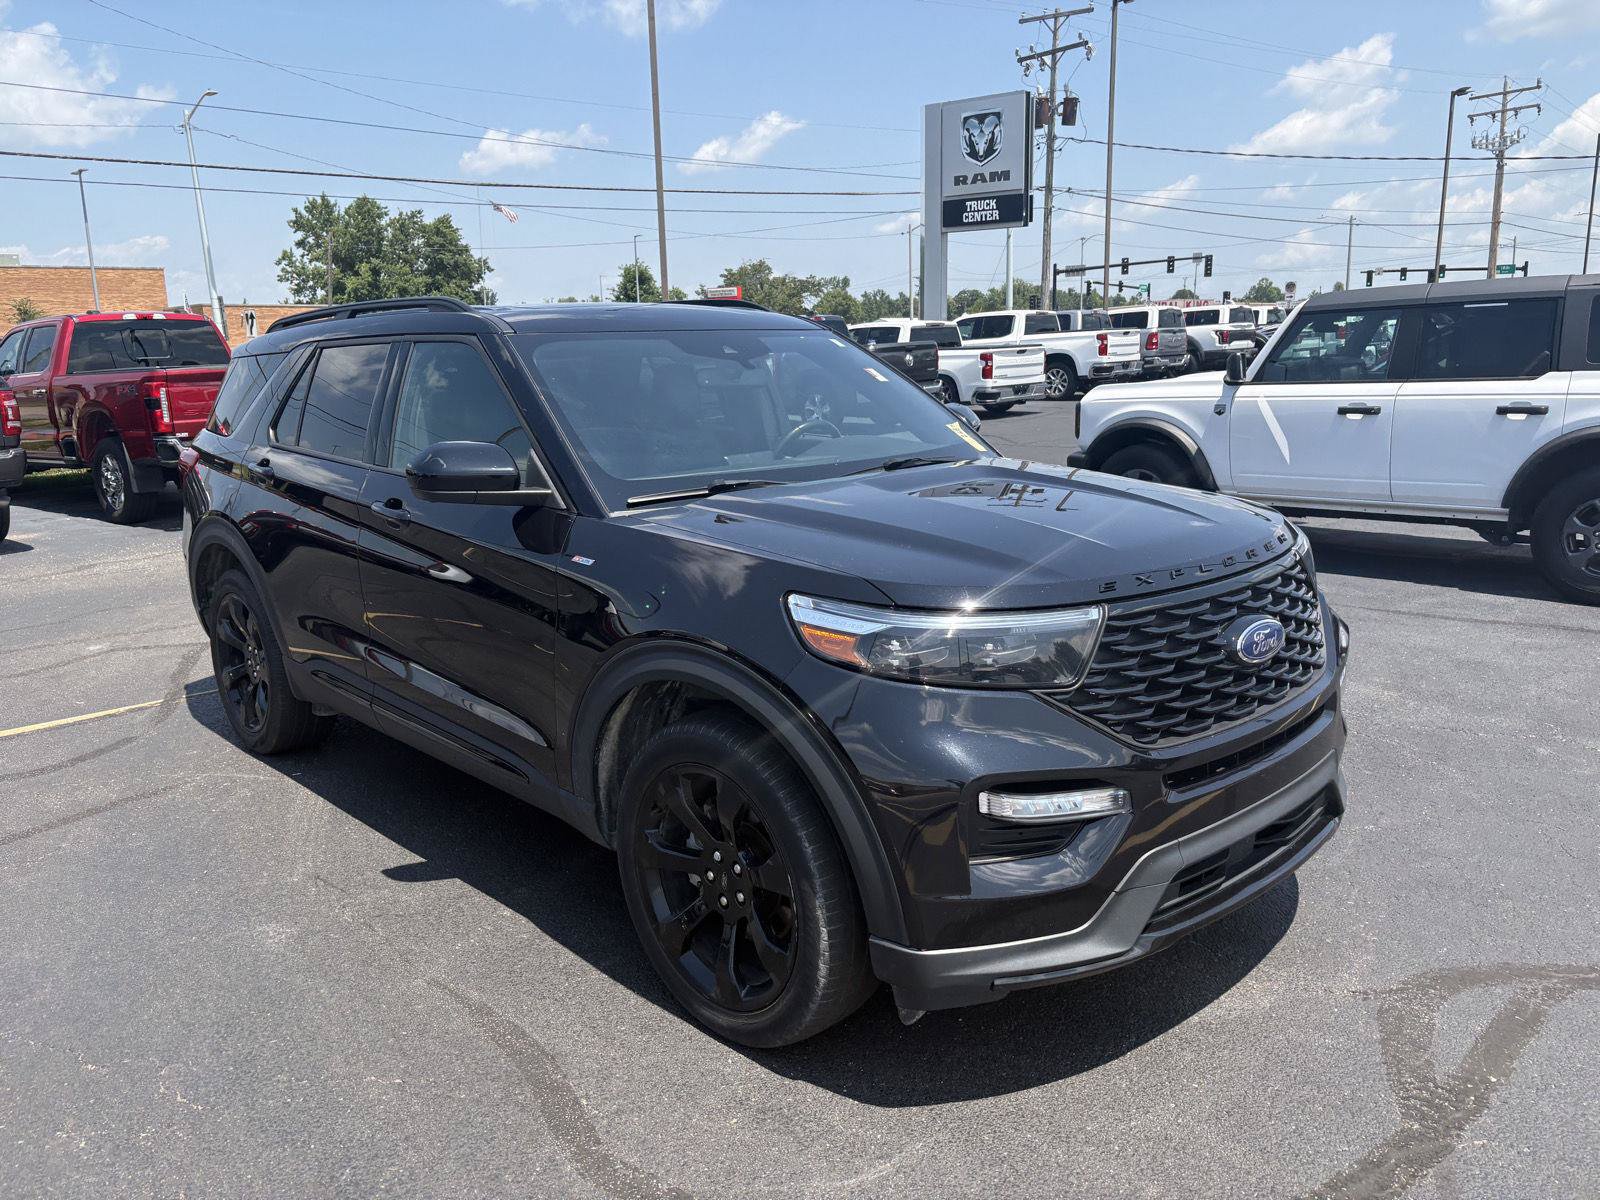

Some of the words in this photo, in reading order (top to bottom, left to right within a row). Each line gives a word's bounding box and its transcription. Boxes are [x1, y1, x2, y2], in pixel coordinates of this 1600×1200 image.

[953, 170, 1010, 186] RAM
[965, 199, 997, 211] TRUCK
[962, 211, 1000, 222] CENTER
[1098, 533, 1287, 593] EXPLORER
[1252, 627, 1280, 655] Ford
